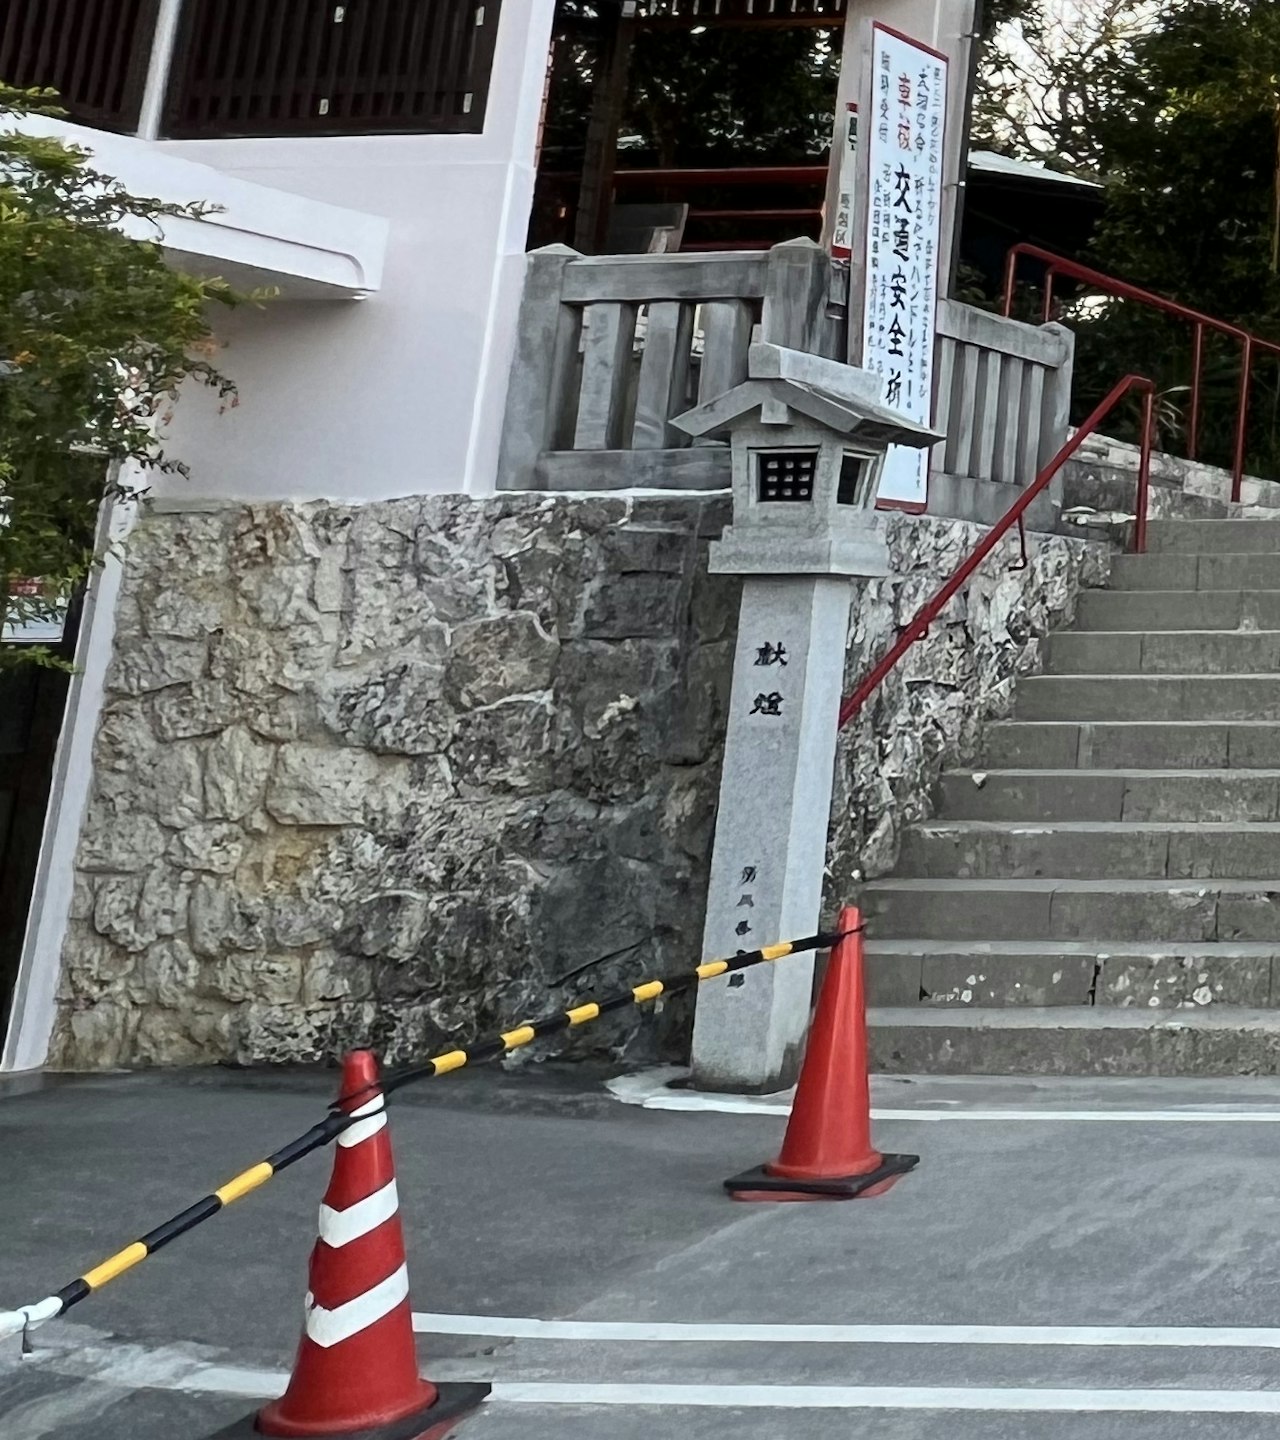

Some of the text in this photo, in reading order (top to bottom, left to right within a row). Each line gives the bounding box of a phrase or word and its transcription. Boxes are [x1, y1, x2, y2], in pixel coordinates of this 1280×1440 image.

[885, 162, 912, 448] 交通安全祈
